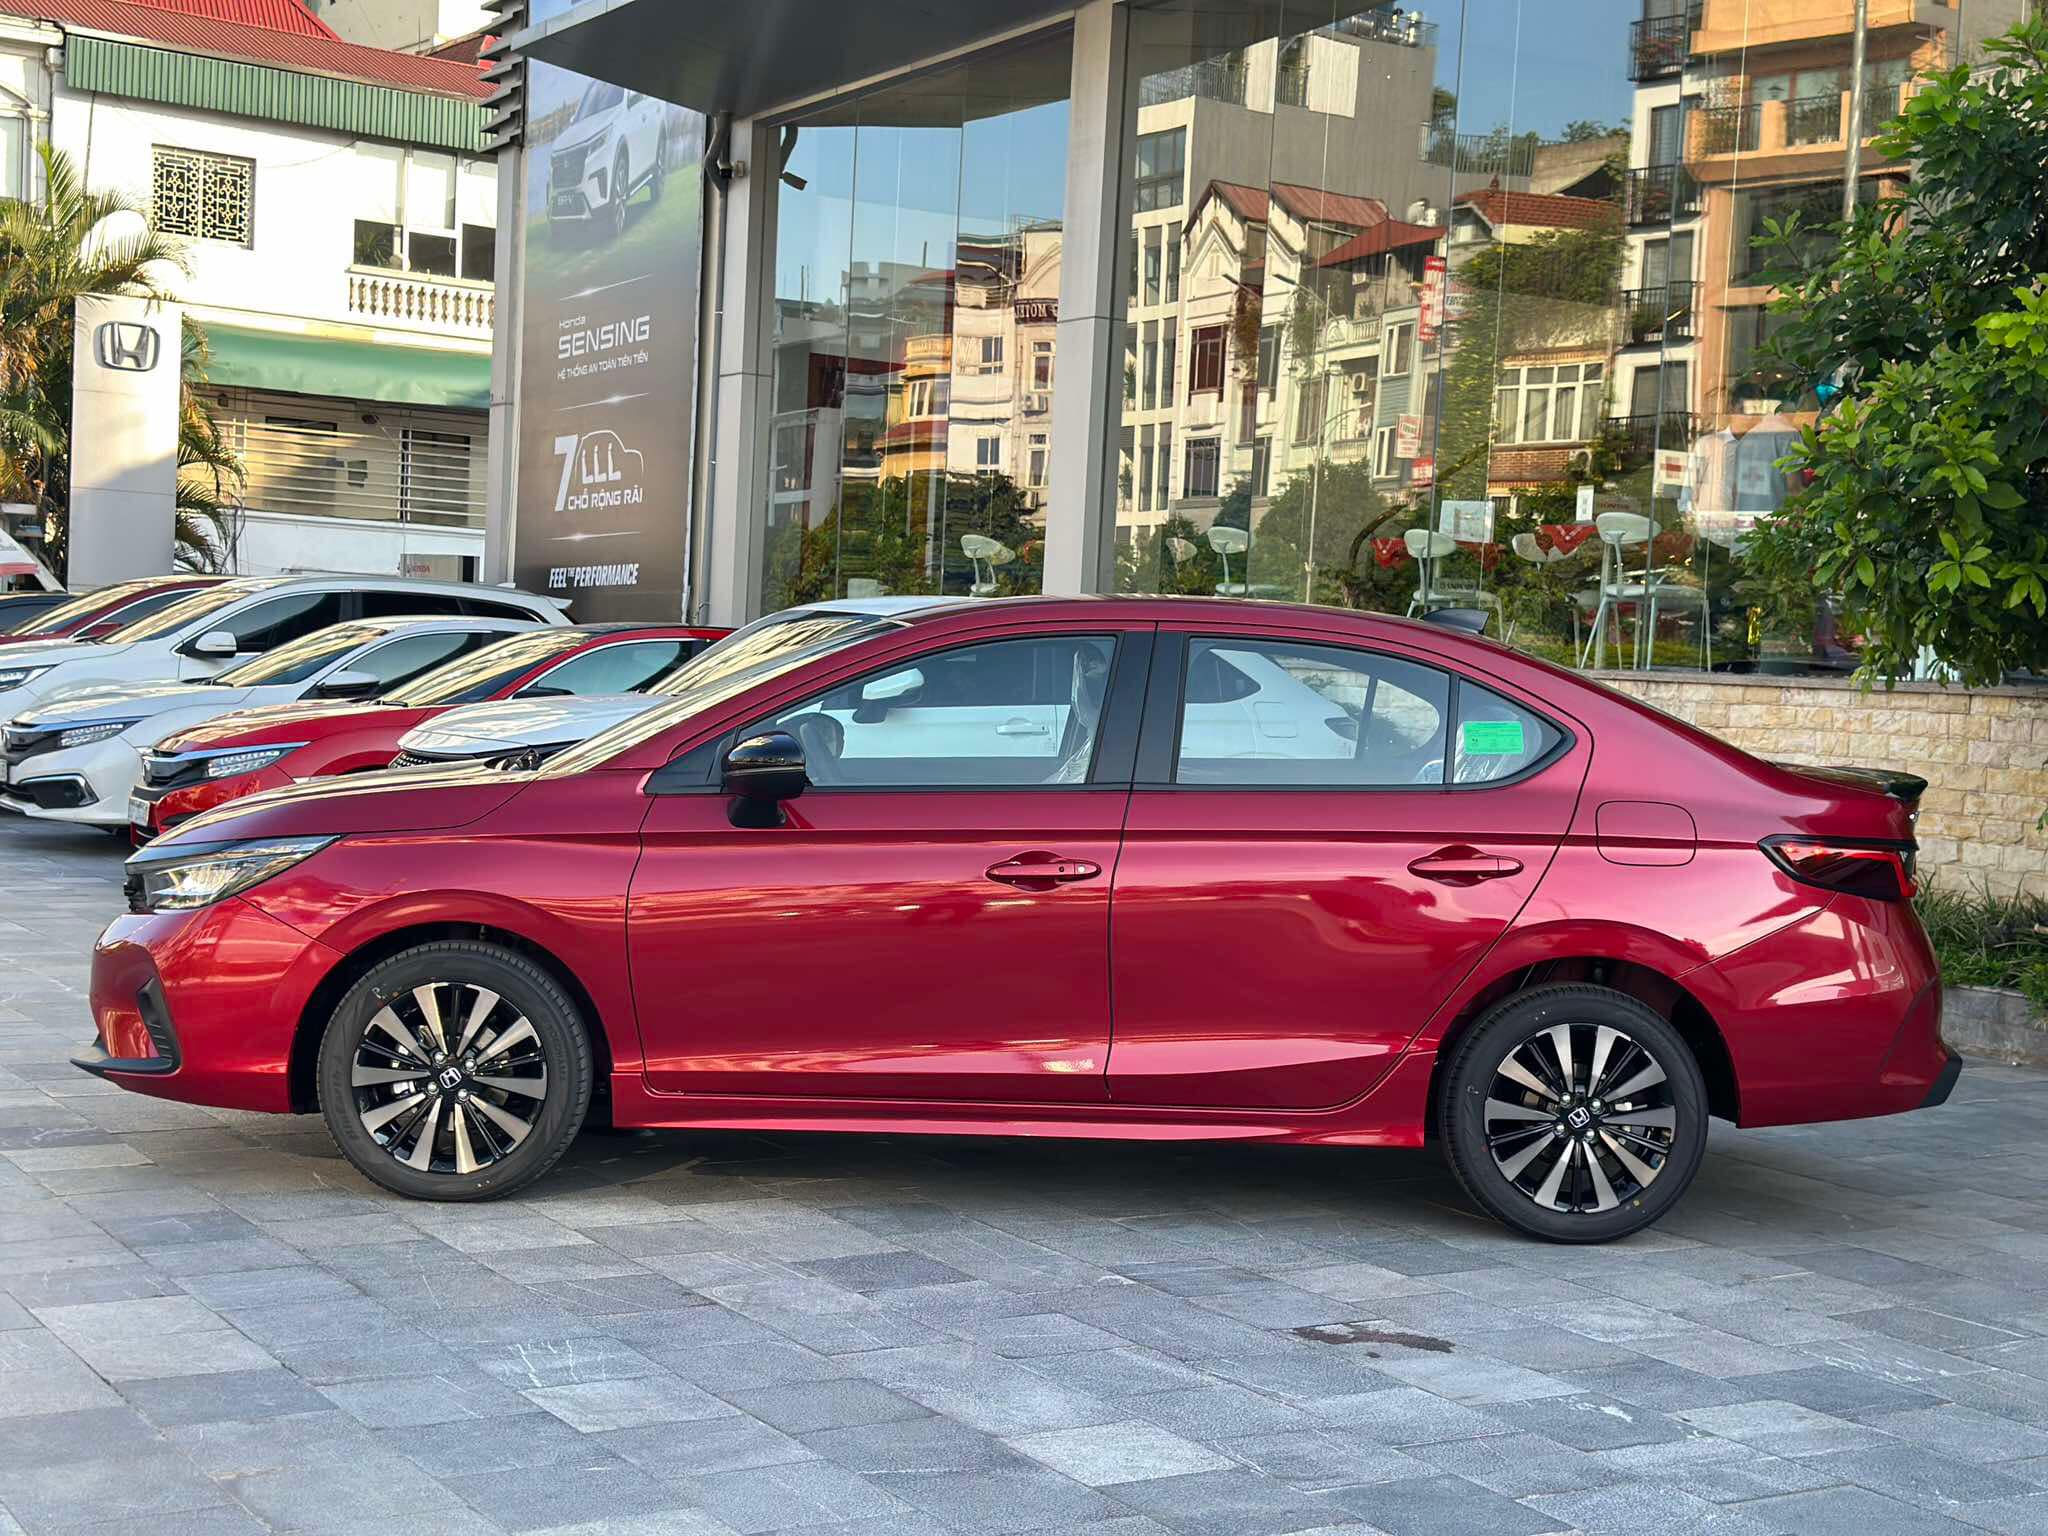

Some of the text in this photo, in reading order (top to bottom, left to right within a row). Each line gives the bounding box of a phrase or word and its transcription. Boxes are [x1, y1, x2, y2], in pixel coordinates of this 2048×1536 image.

[559, 315, 586, 329] Honda
[558, 315, 650, 359] SENSING
[588, 363, 598, 374] AN
[554, 433, 643, 512] 7 CHỖ RỘNG RÃI
[549, 567, 567, 588] FEEL
[574, 563, 640, 588] PERFORMANCE
